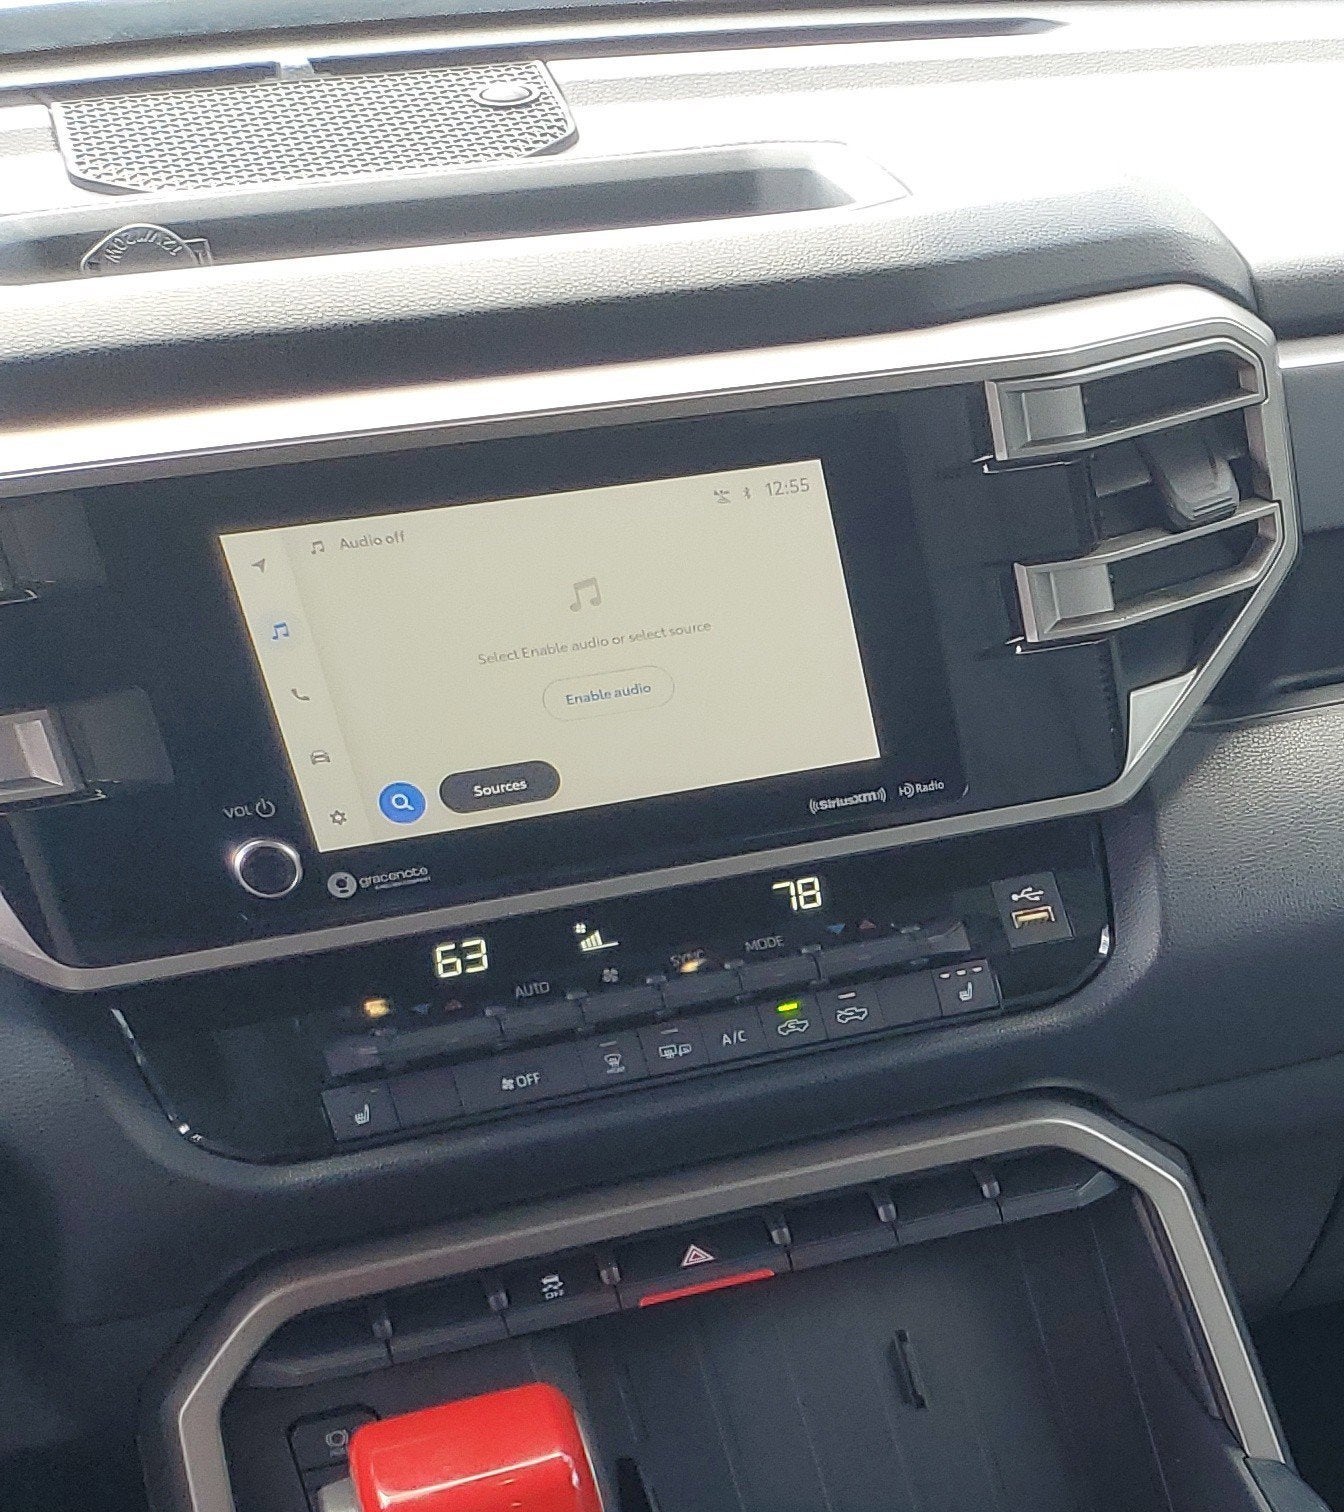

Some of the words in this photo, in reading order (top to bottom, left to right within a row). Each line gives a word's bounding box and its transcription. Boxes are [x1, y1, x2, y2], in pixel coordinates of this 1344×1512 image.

[765, 478, 810, 498] 12:55
[340, 532, 382, 550] Audio
[385, 529, 406, 546] off
[478, 649, 520, 665] Select
[521, 642, 569, 659] Enable
[571, 636, 609, 652] audio
[612, 634, 626, 646] or
[628, 628, 668, 643] select
[669, 621, 712, 636] source
[565, 689, 612, 706] Enable
[614, 683, 652, 698] audio
[473, 779, 528, 798] Sources
[915, 780, 945, 794] Radio
[222, 804, 252, 819] VOL
[359, 866, 429, 889] gracenote
[771, 876, 822, 911] 78
[744, 934, 785, 953] MODE
[435, 938, 489, 979] 63
[515, 980, 551, 999] AUTO
[721, 1028, 748, 1047] A/C
[515, 1071, 542, 1089] OFF
